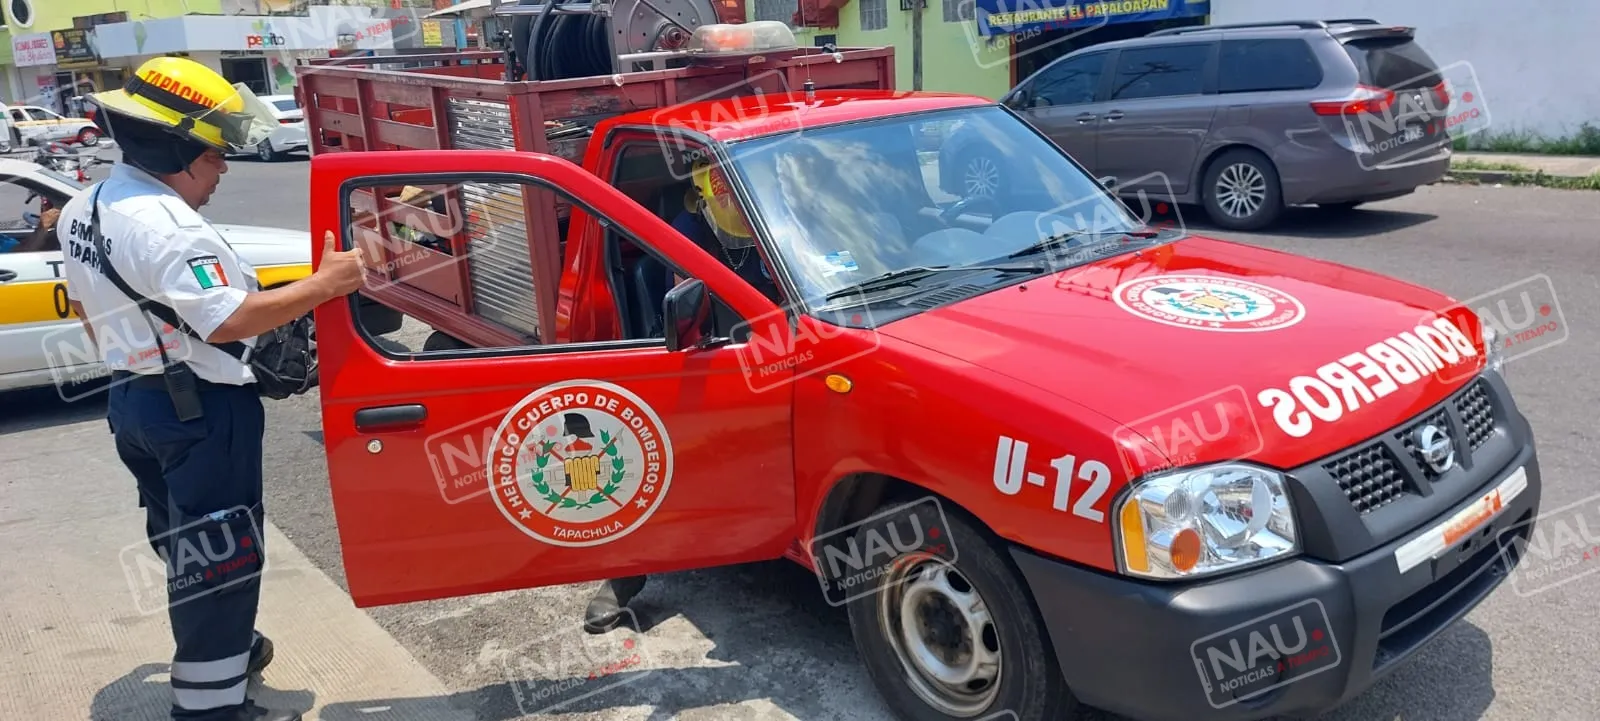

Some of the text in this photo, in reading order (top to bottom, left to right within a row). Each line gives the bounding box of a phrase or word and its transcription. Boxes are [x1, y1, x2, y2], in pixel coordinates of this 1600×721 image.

[988, 8, 1066, 26] RESTAURANTE
[1068, 4, 1084, 19] EL
[1086, 0, 1168, 17] PAPALOAPAN
[247, 33, 285, 48] pepito
[500, 392, 660, 508] HEROICO CUERPO DE BOMBEROS
[992, 435, 1112, 524] U-12
[552, 519, 624, 540] TAPACHULA
